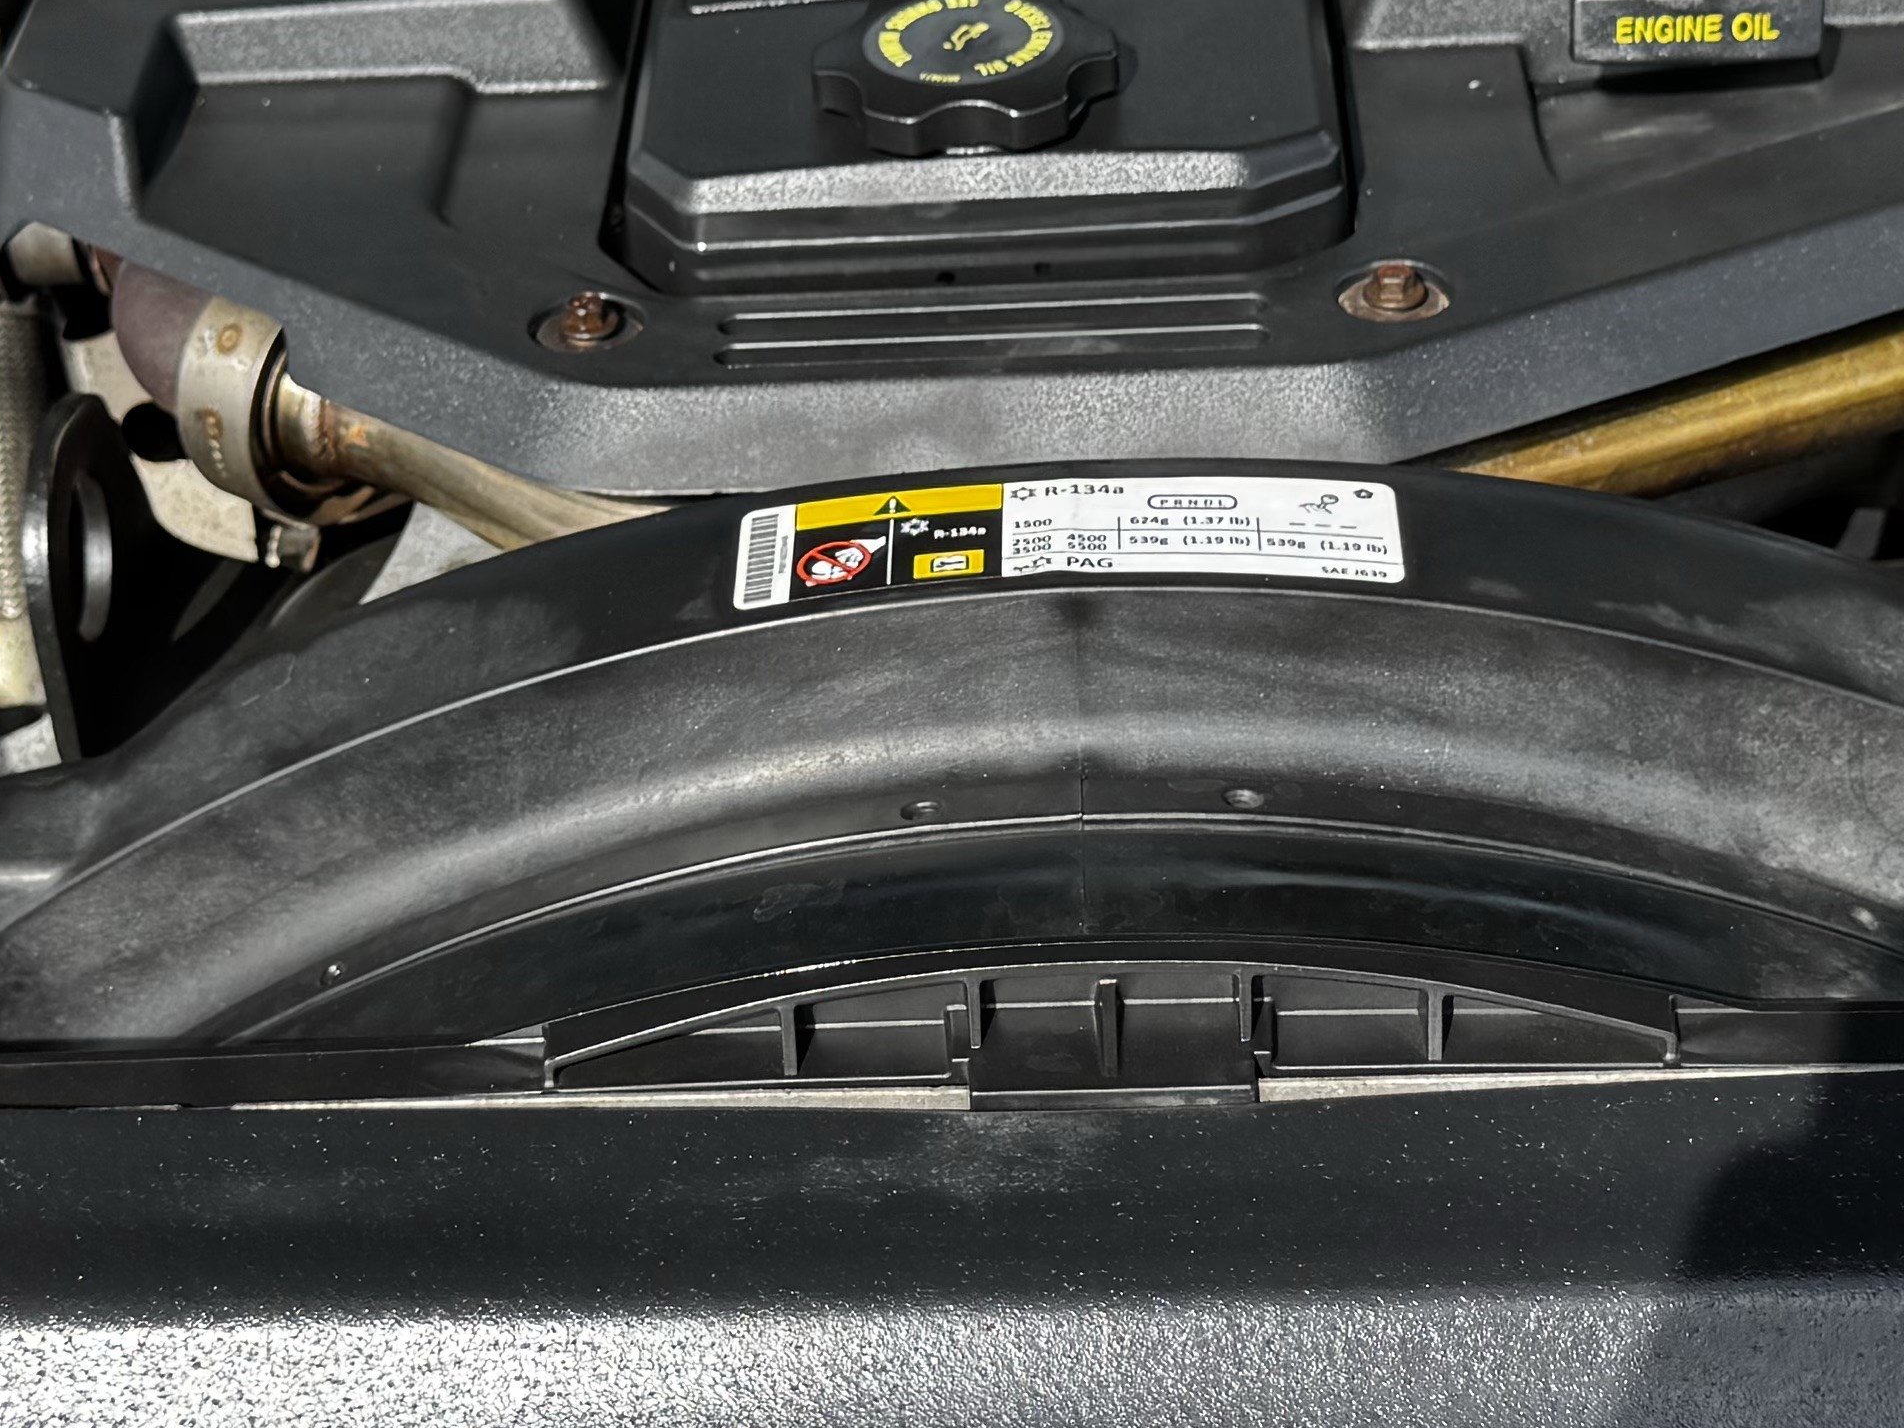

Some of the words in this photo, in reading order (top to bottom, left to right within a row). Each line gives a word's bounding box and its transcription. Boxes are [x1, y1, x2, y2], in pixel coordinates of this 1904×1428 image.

[1616, 14, 1723, 44] ENGINE
[1731, 12, 1780, 42] OIL
[1044, 483, 1125, 497] R-134a
[1013, 517, 1053, 529] 1500
[1228, 515, 1251, 528] lb)
[1129, 535, 1169, 546] 539g
[1228, 535, 1251, 548] lb)
[1366, 542, 1388, 556] lb)
[1066, 556, 1114, 570] PAG
[1322, 566, 1348, 576] SAE
